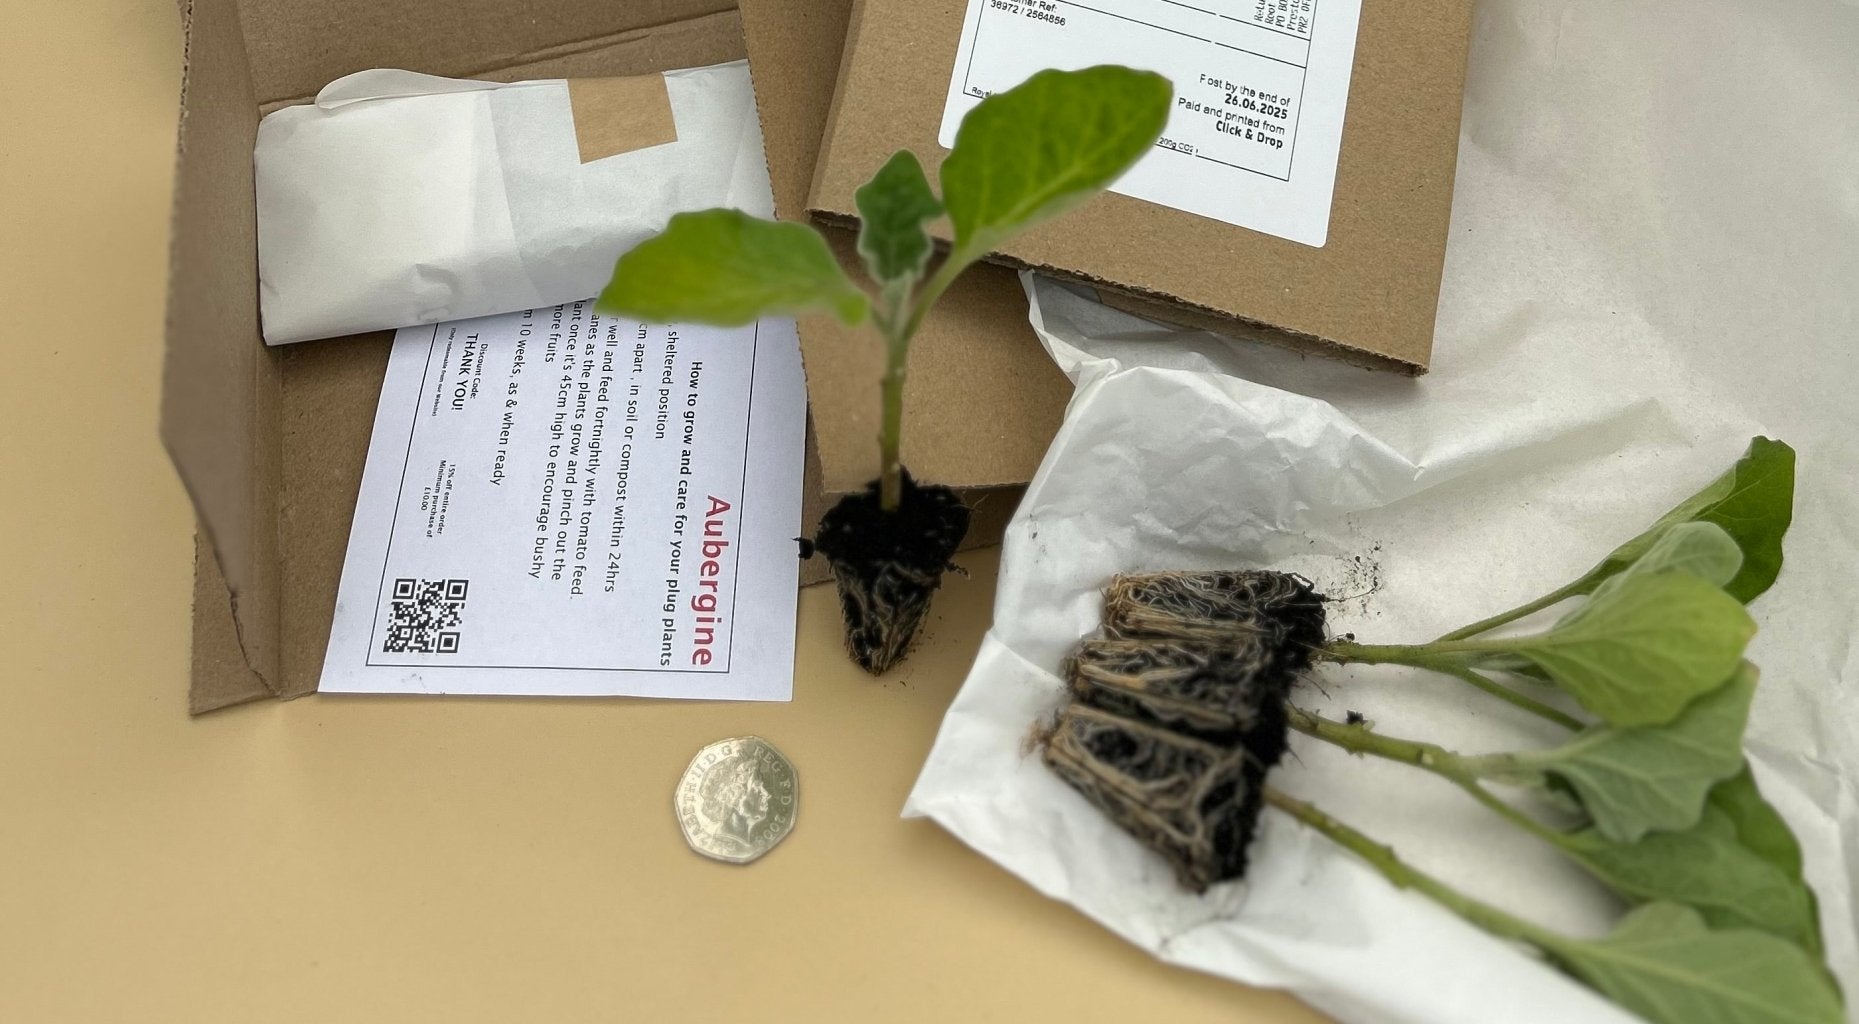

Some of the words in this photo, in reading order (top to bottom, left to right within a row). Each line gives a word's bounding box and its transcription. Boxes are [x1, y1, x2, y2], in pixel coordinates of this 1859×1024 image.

[1025, 8, 1066, 26] 2564856
[1038, 0, 1057, 12] Ref:
[1263, 3, 1276, 25] Root
[1274, 14, 1286, 28] PO
[1296, 15, 1309, 34] PR2
[1224, 80, 1238, 94] by
[1239, 85, 1256, 98] the
[1258, 91, 1278, 104] end
[1279, 97, 1291, 107] of
[1224, 92, 1288, 120] 26.06.2025
[1202, 106, 1223, 118] and
[1224, 111, 1260, 128] printed
[1262, 119, 1285, 135] from
[1215, 119, 1242, 137] Click
[1244, 127, 1253, 141] &
[1256, 131, 1283, 150] Drop
[519, 323, 533, 336] 10
[566, 323, 579, 351] once
[605, 324, 618, 347] well
[458, 332, 479, 376] THANK
[474, 343, 489, 376] Discount
[508, 339, 527, 378] weeks,
[543, 332, 562, 363] fruits
[584, 343, 595, 356] as
[601, 350, 614, 372] and
[632, 342, 645, 373] apart
[661, 331, 680, 384] sheltered
[562, 354, 576, 371] it's
[580, 359, 595, 378] the
[688, 361, 703, 389] How
[450, 379, 469, 410] YOU!
[469, 377, 481, 399] Code:
[507, 382, 519, 395] as
[556, 374, 573, 408] 45cm
[574, 382, 591, 419] plants
[597, 375, 613, 402] feed
[629, 384, 642, 396] in
[686, 393, 698, 407] to
[504, 398, 518, 408] &
[625, 399, 638, 422] soil
[654, 388, 670, 439] position
[498, 411, 515, 445] when
[550, 412, 568, 440] high
[569, 423, 583, 456] grow
[584, 405, 609, 475] fortnightly
[623, 425, 634, 440] or
[682, 410, 695, 445] grow
[548, 444, 561, 458] to
[679, 449, 692, 475] and
[434, 459, 447, 494] Minimum
[447, 463, 456, 478] 15%
[489, 449, 506, 486] ready
[564, 459, 578, 484] and
[615, 443, 632, 502] compost
[420, 486, 432, 511] £10.00
[445, 479, 453, 491] off
[535, 461, 557, 532] encourage
[582, 477, 597, 506] with
[675, 479, 688, 510] care
[427, 495, 439, 528] purchase
[440, 491, 450, 513] entire
[559, 489, 575, 525] pinch
[425, 529, 433, 538] of
[436, 514, 445, 535] order
[575, 510, 592, 560] tomato
[609, 504, 626, 547] within
[673, 514, 688, 537] for
[554, 530, 567, 554] out
[527, 537, 549, 579] bushy
[550, 558, 566, 580] the
[669, 540, 682, 575] your
[569, 565, 587, 600] feed.
[604, 552, 621, 592] 24hrs
[690, 494, 731, 666] Aubergine
[662, 579, 681, 613] plug
[659, 618, 677, 666] plants
